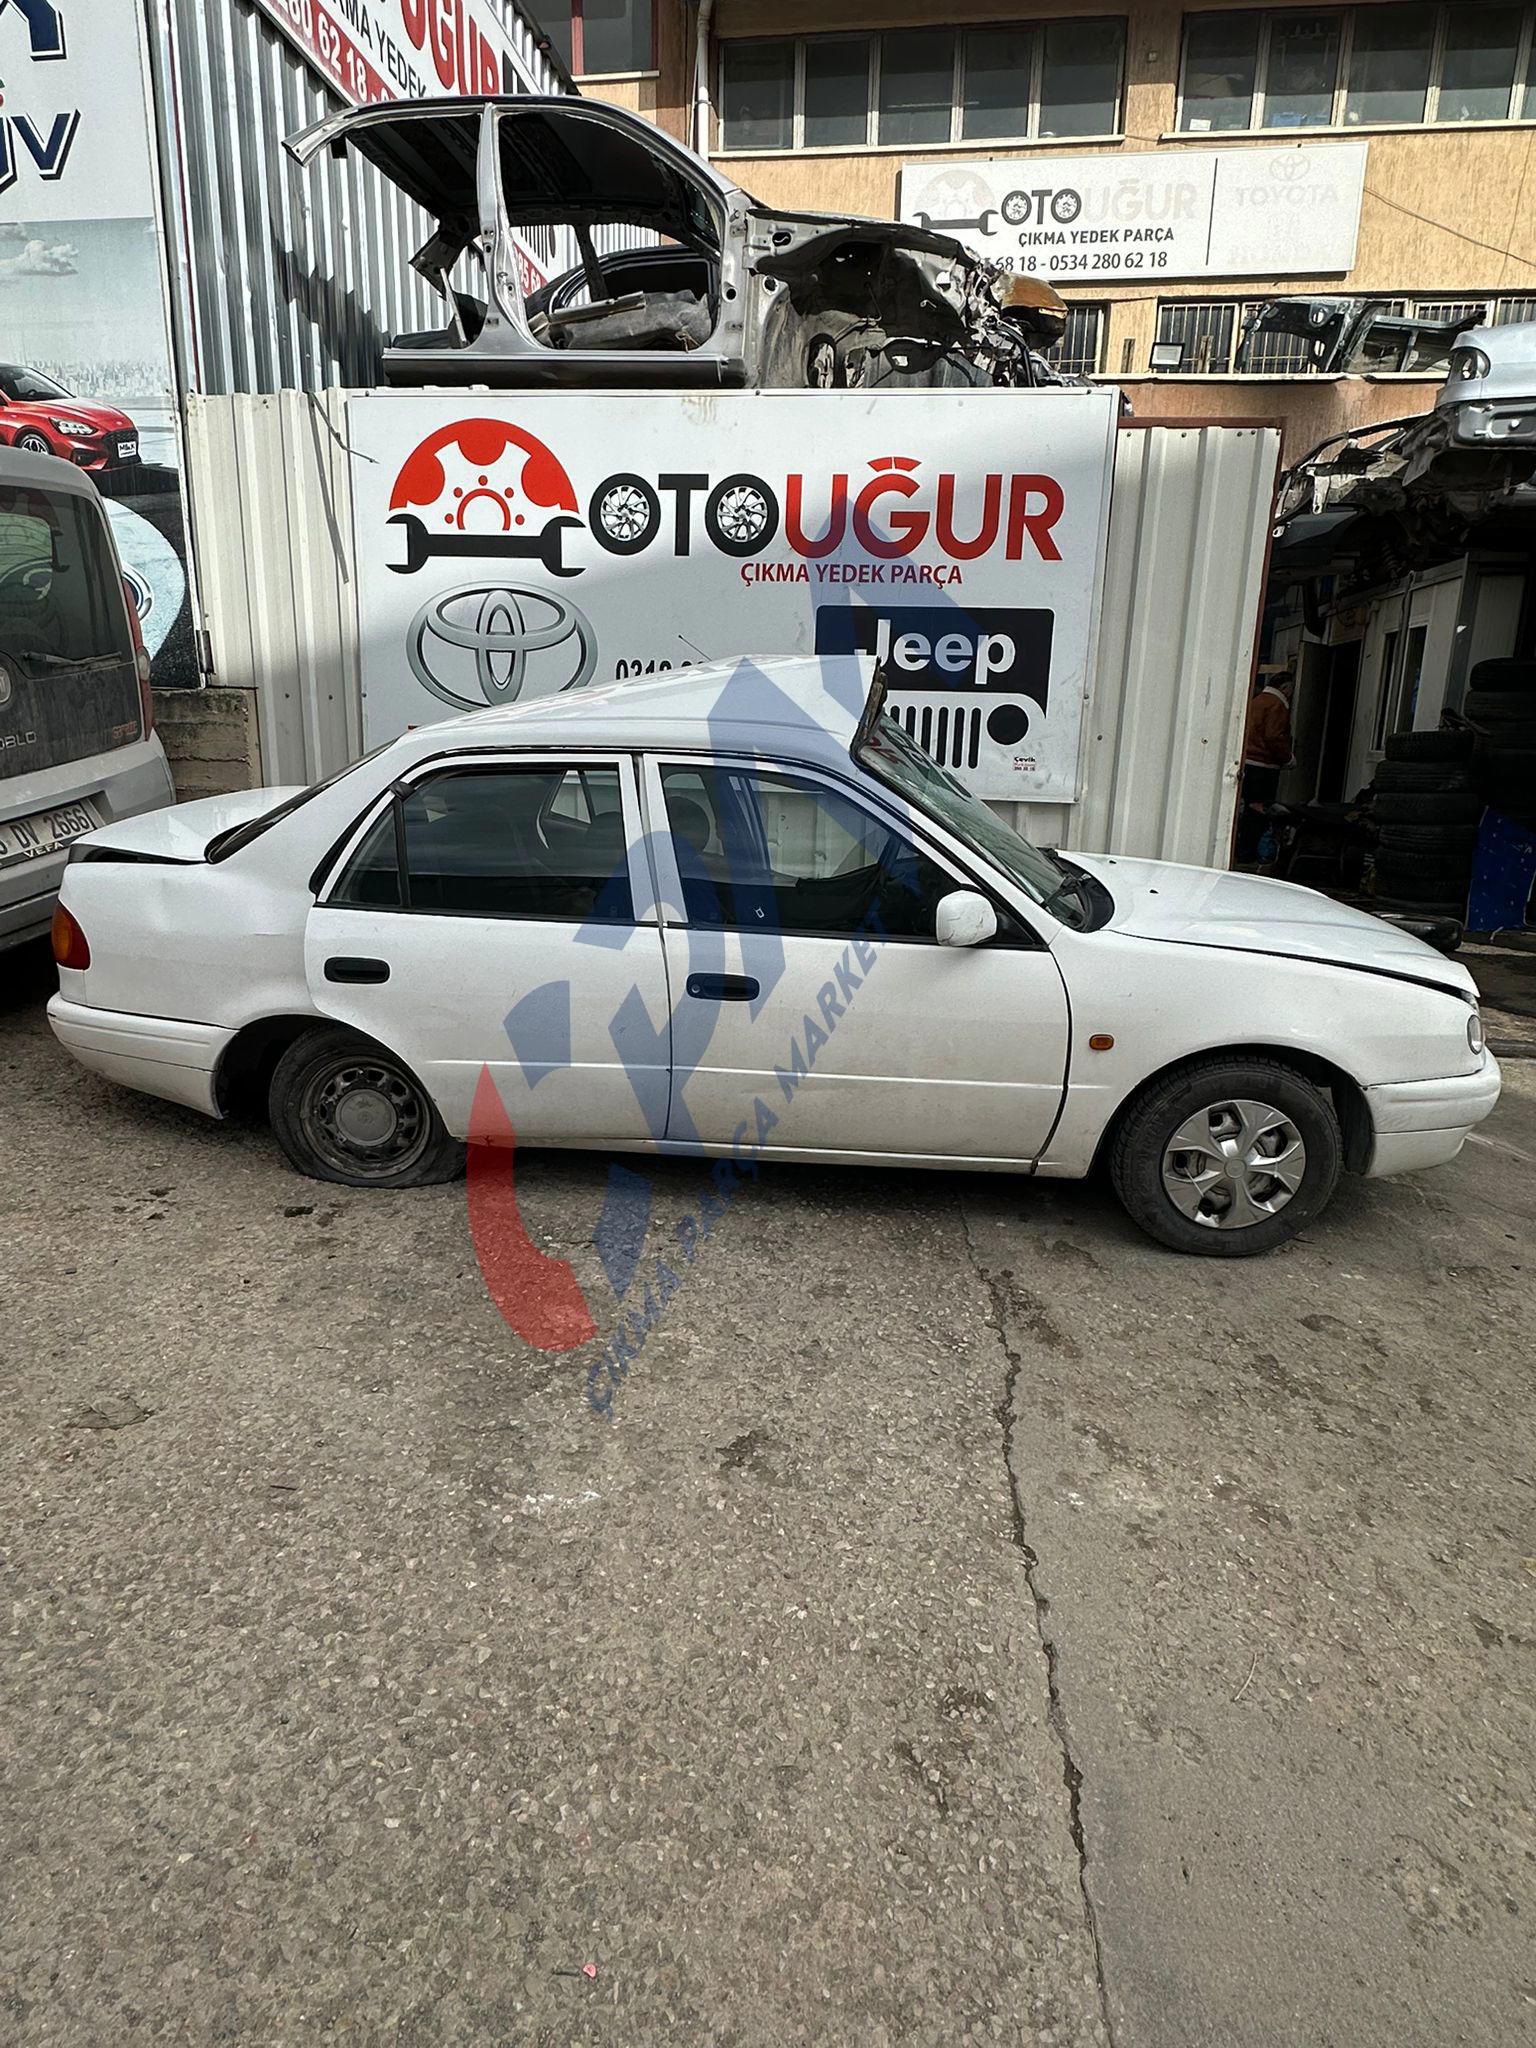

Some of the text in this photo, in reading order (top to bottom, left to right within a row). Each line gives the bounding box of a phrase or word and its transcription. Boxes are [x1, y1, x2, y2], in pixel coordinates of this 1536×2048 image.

[1235, 183, 1338, 207] TOYOTA
[1018, 226, 1175, 248] ÇIKMA YEDEK PARÇA
[1019, 255, 1037, 272] 18
[1049, 254, 1089, 271] 0534
[1091, 252, 1122, 270] 280
[1124, 251, 1145, 269] 62
[1149, 251, 1168, 268] 18
[740, 562, 963, 589] ÇIKMA YEDEK PARÇA
[854, 618, 1016, 685] Jeep
[9, 820, 41, 849] DV
[43, 807, 90, 840] 2666
[23, 841, 65, 858] VEFA
